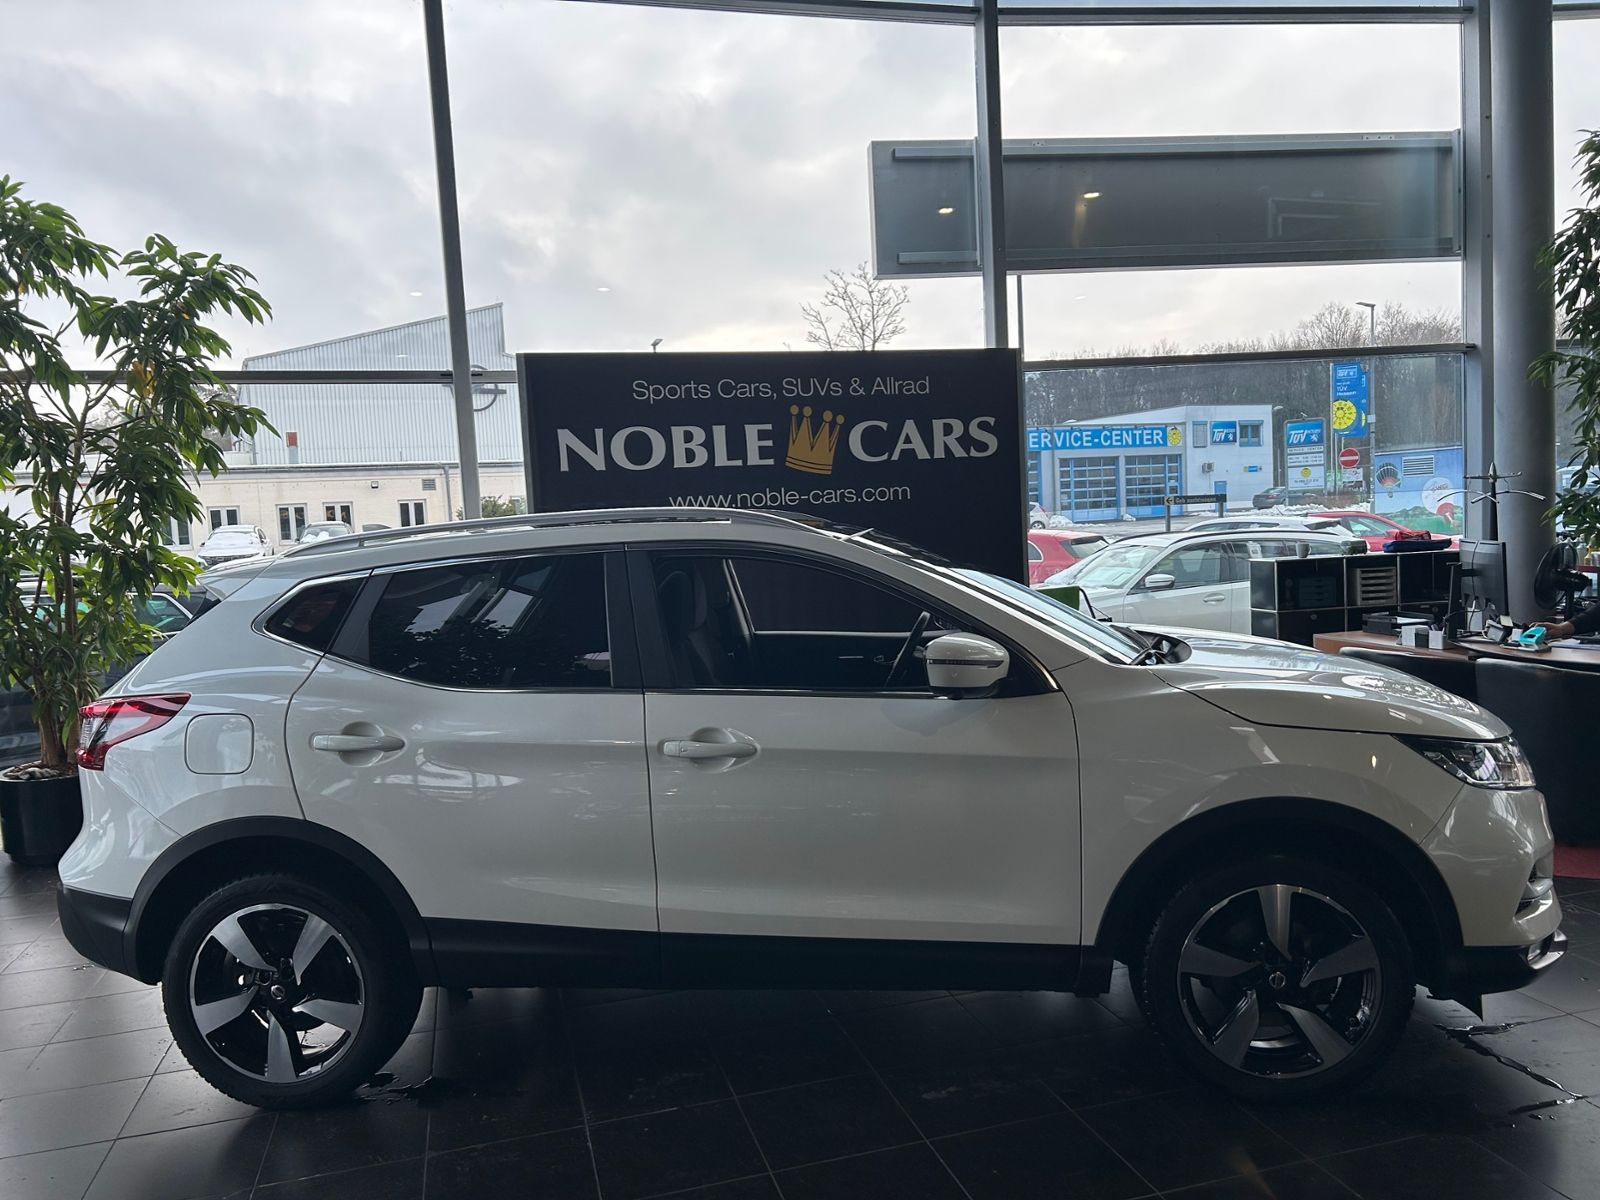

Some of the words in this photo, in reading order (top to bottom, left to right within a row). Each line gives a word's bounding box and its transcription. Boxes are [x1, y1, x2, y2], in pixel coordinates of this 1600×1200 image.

[632, 380, 711, 404] Sports
[717, 379, 777, 400] Cars,
[782, 378, 842, 397] SUVs
[849, 377, 865, 396] &
[871, 376, 930, 396] Allrad
[556, 423, 775, 472] NOBLE
[848, 416, 999, 462] CARS
[1028, 429, 1164, 449] ERVICE-CENTER
[668, 485, 911, 508] www.noble-cars.com
